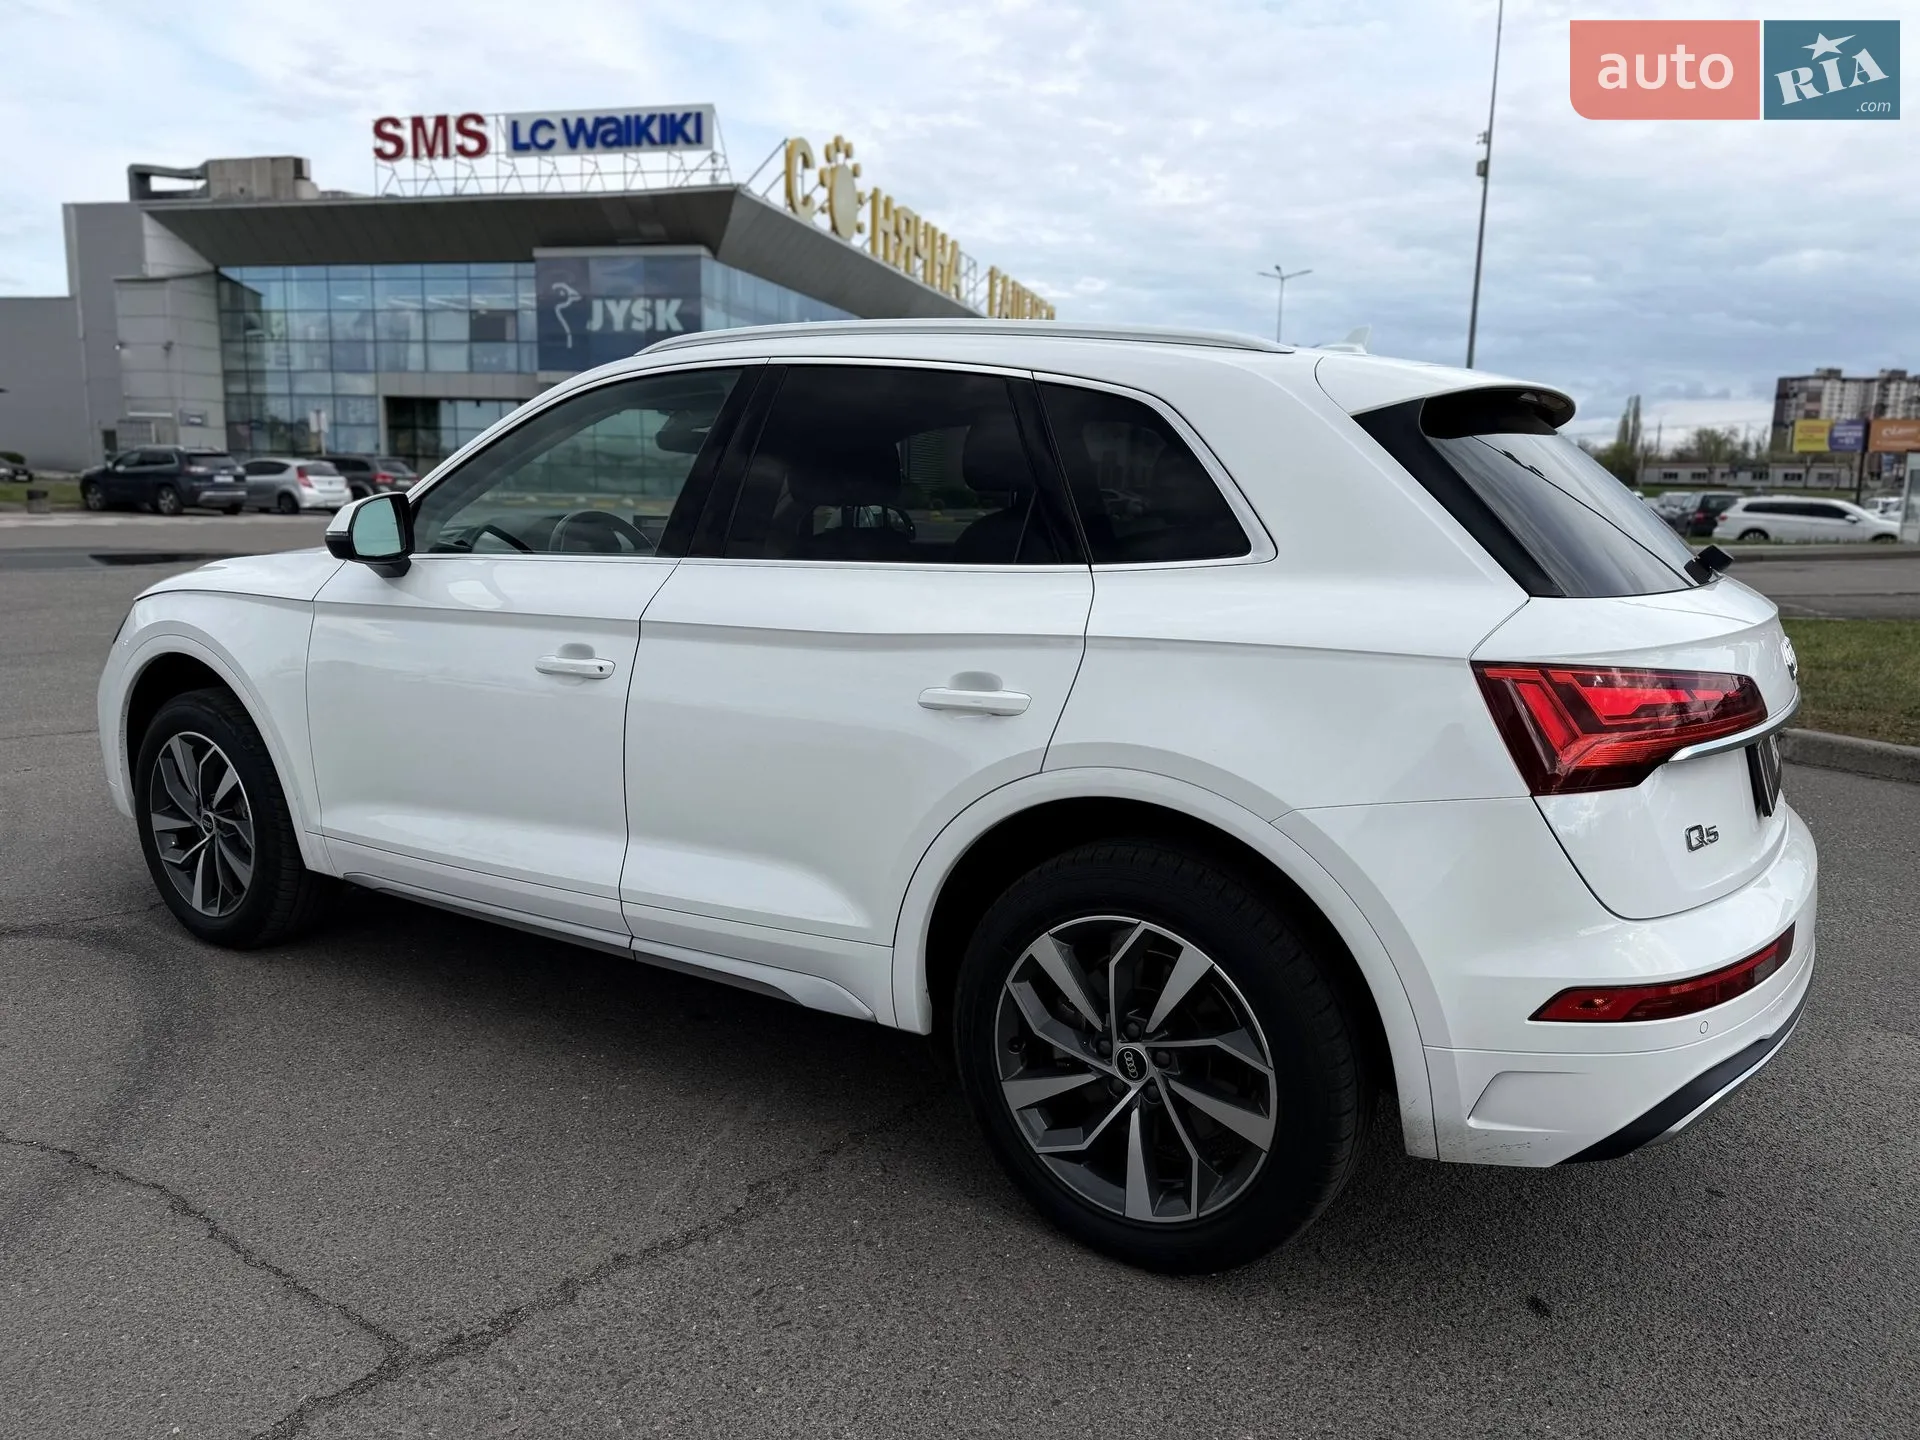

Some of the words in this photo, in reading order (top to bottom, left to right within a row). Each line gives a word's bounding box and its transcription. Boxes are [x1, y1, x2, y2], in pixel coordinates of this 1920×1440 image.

[373, 113, 489, 161] SMS
[511, 118, 556, 152] LC
[586, 297, 684, 332] JYSK
[1684, 824, 1720, 853] Q5
